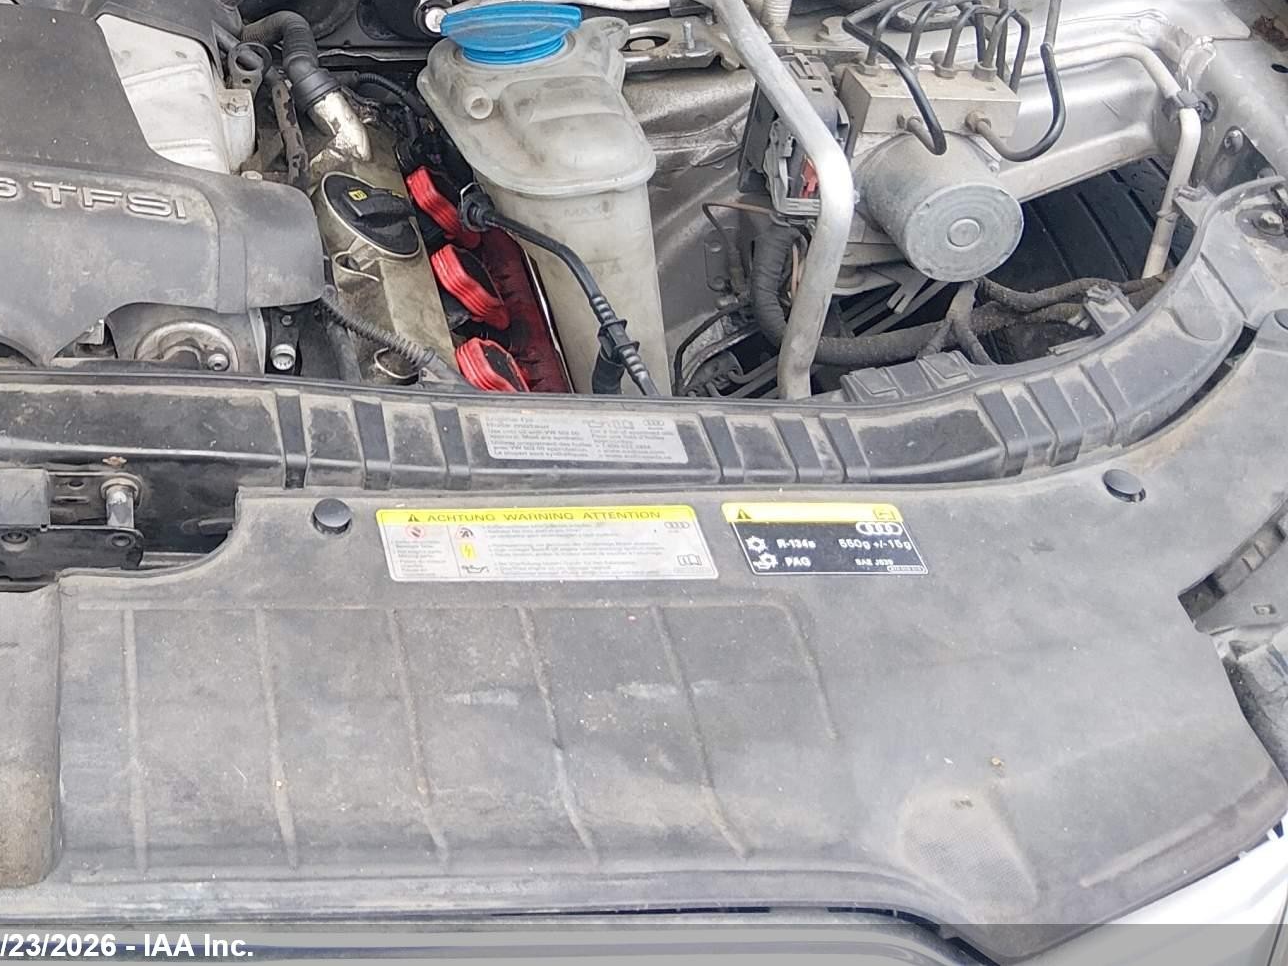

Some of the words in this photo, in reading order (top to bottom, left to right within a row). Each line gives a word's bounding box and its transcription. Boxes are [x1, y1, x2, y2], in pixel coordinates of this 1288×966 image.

[32, 180, 188, 219] TFSI
[427, 513, 497, 522] ACHTUNG
[503, 512, 574, 522] WARNING
[582, 510, 661, 521] ATTENTION
[783, 555, 811, 567] PAG
